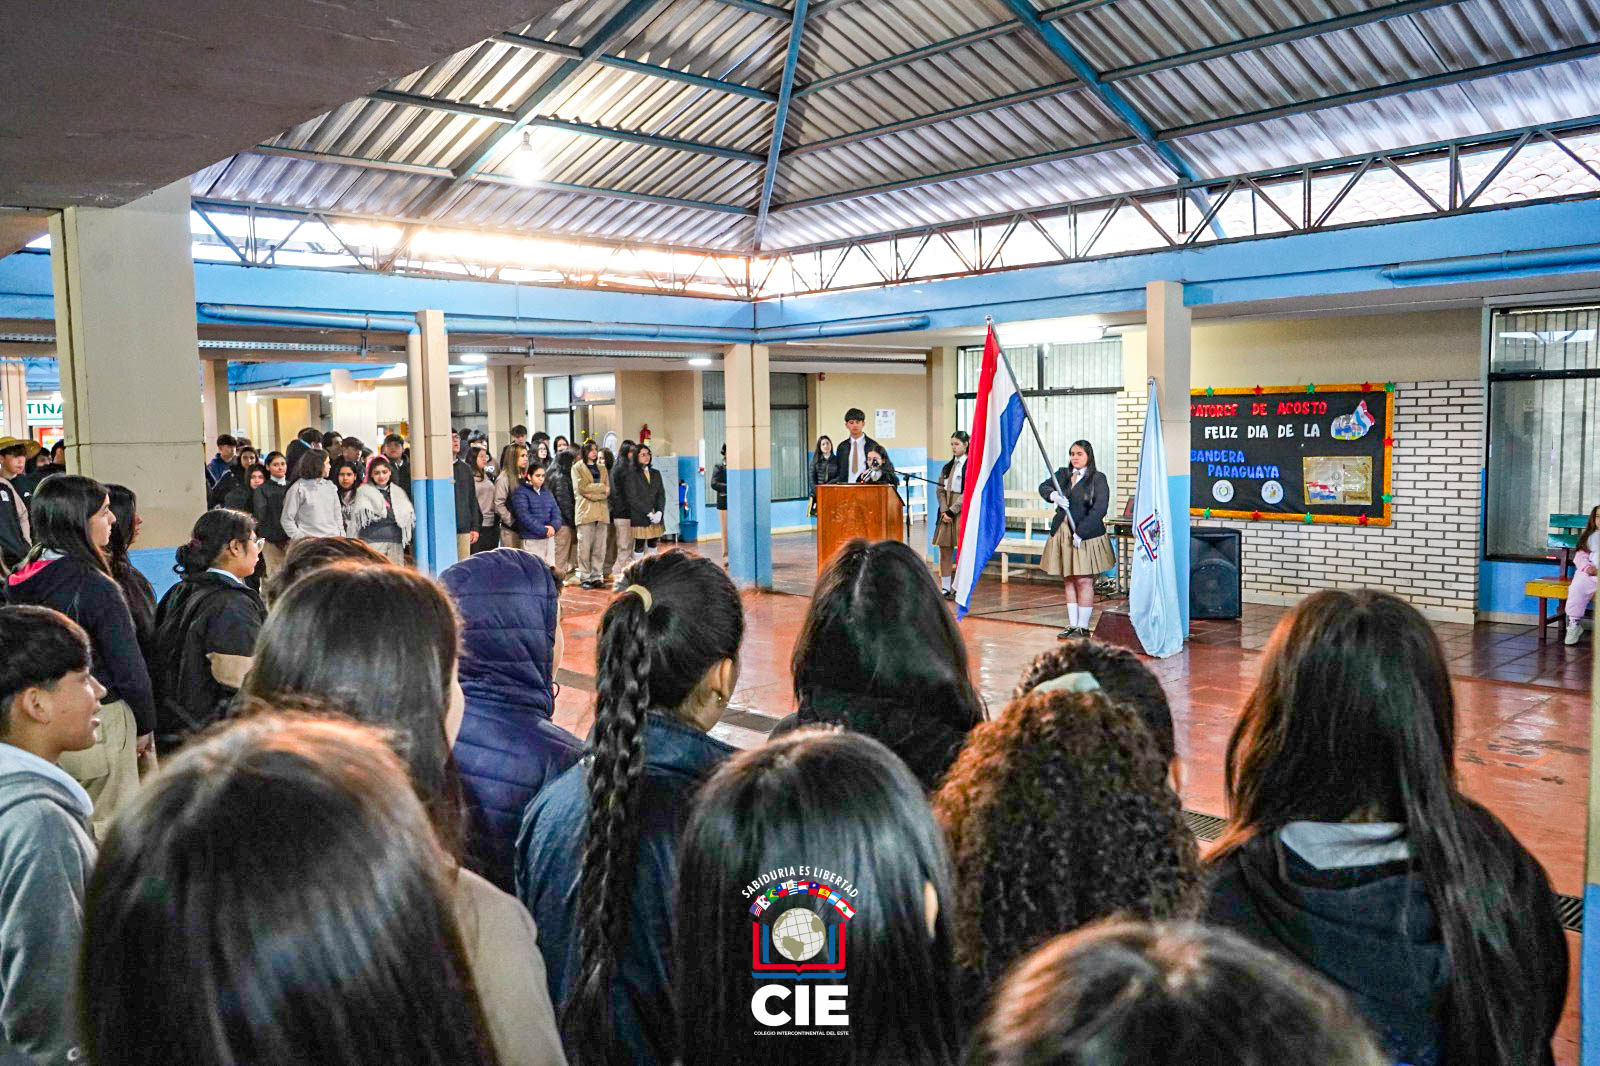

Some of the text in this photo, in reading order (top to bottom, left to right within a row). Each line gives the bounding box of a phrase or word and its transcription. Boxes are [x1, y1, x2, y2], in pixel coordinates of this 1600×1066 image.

[1190, 404, 1239, 417] CATORCE
[1252, 403, 1267, 416] DE
[1204, 424, 1320, 439] FELIZ DIA DE LA
[1190, 450, 1245, 463] BANDERA
[1208, 464, 1280, 478] PARAGUAYA
